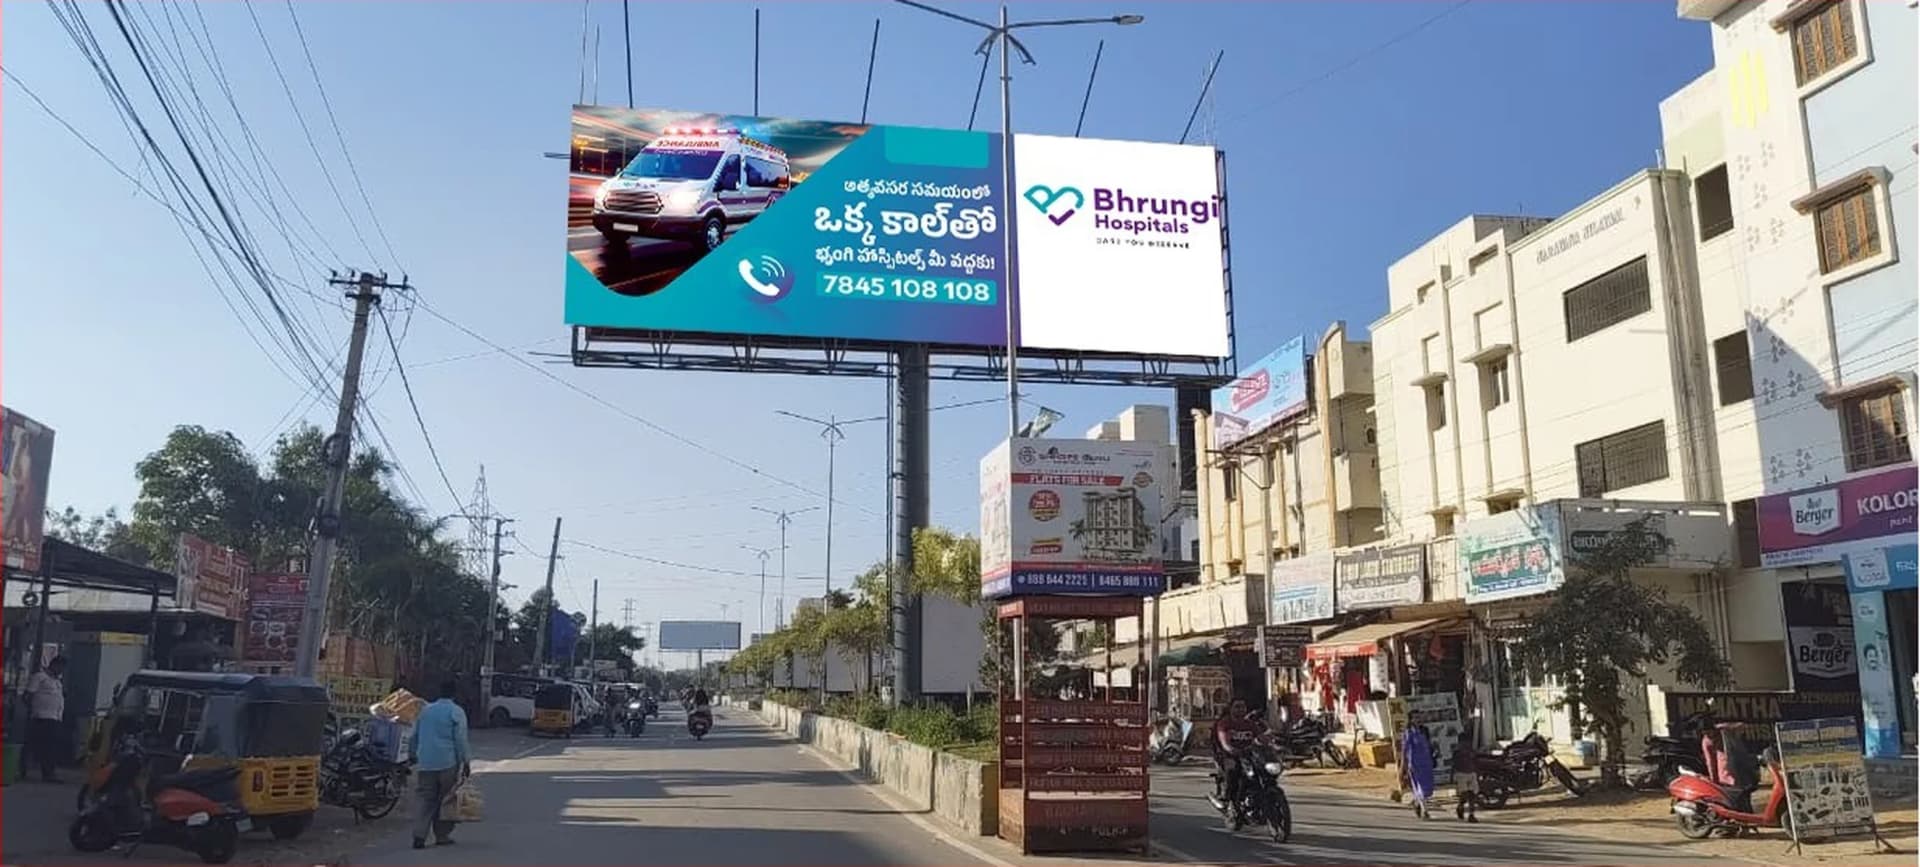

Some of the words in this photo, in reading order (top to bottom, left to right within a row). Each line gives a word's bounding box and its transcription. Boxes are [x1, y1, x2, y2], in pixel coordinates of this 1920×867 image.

[1094, 188, 1219, 224] Bhrungi
[814, 202, 876, 246] ఒక్క
[1095, 215, 1189, 235] Hospitals
[928, 252, 946, 267] మీ
[823, 275, 885, 295] 7845
[891, 279, 937, 298] 108
[944, 282, 990, 301] 108
[1796, 507, 1834, 525] Berger
[1800, 645, 1852, 668] Berger
